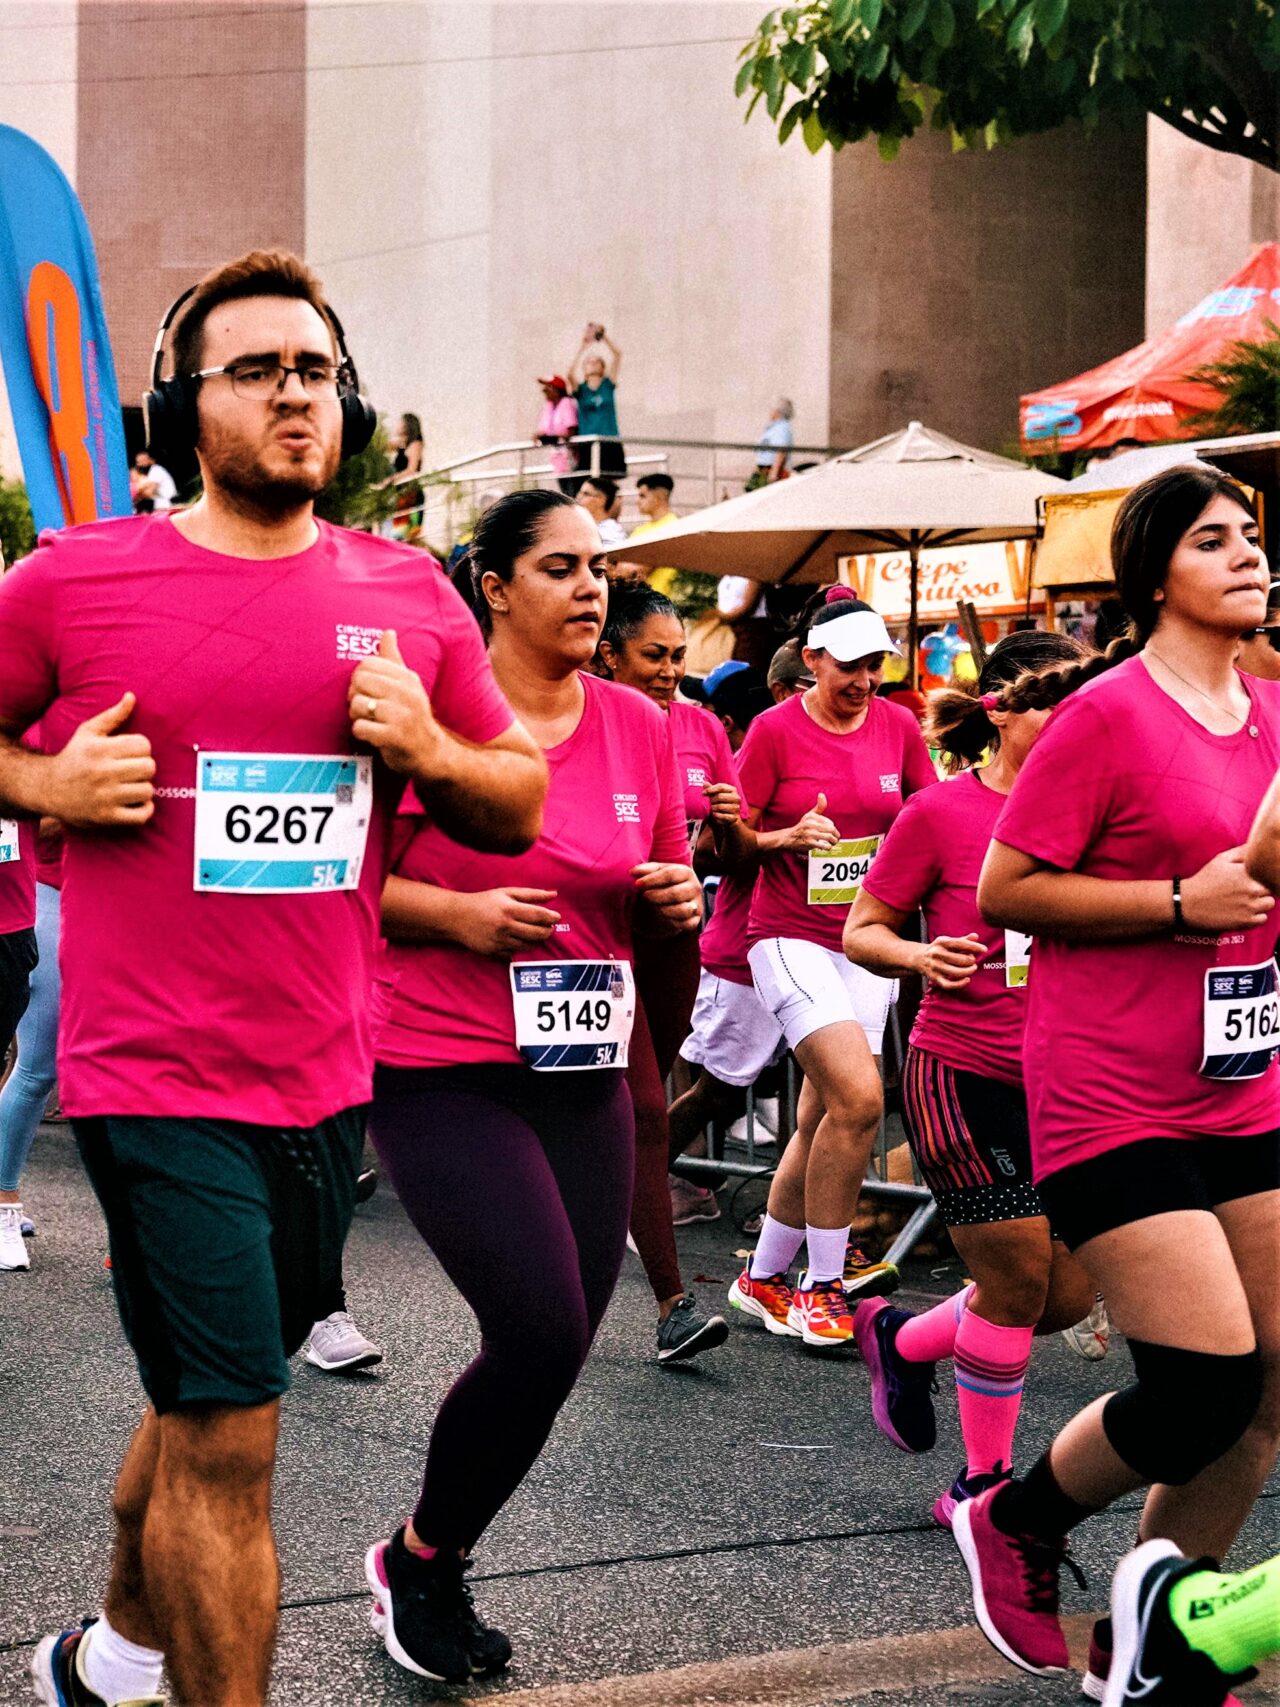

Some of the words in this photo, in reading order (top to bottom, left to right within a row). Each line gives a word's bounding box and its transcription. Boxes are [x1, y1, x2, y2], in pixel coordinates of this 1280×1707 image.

[225, 804, 334, 844] 6267
[615, 802, 639, 816] SESC
[821, 860, 869, 882] 2094
[537, 1000, 611, 1032] 5149
[1224, 1002, 1280, 1041] 5162
